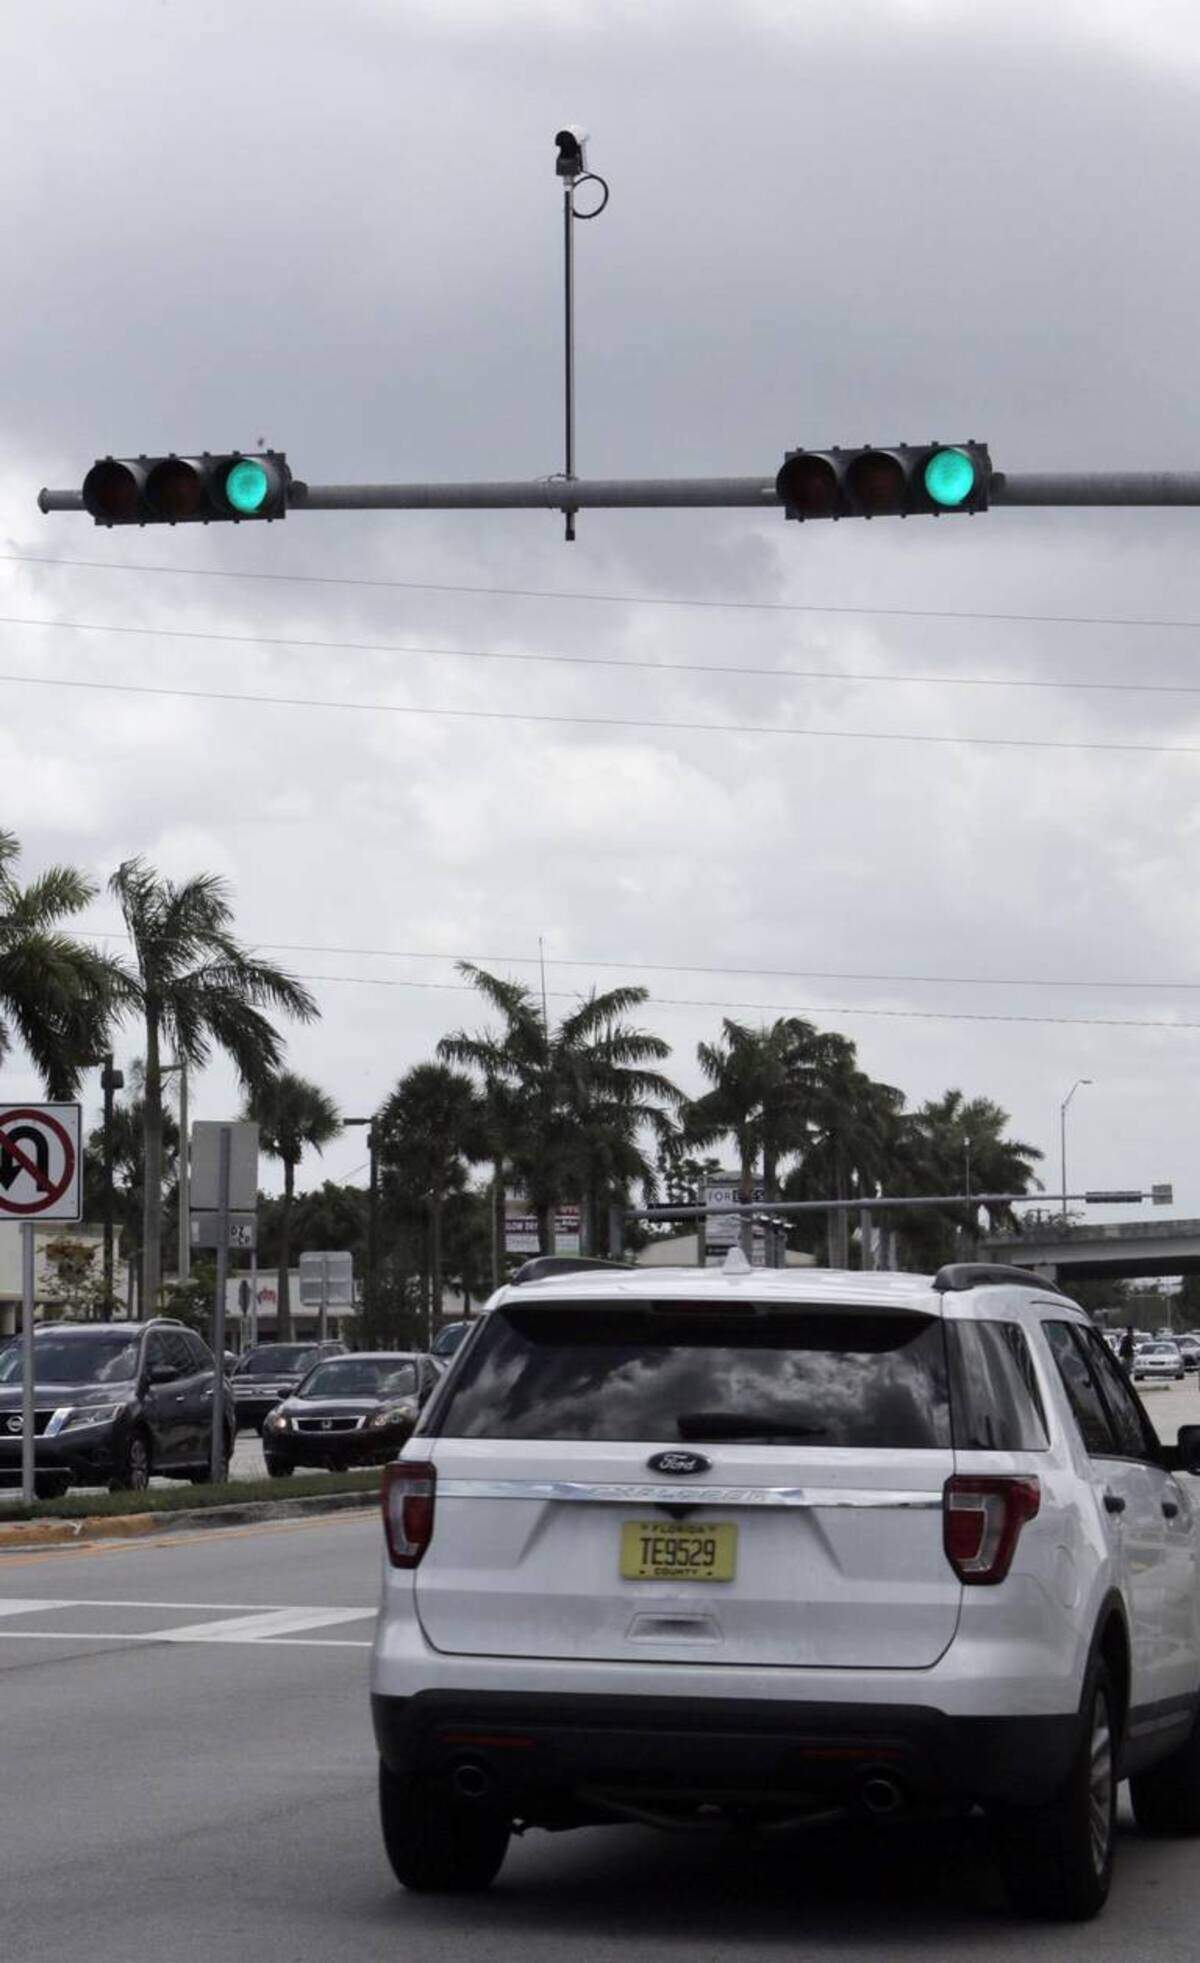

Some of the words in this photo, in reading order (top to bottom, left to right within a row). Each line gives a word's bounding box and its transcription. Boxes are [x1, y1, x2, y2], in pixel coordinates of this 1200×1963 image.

[658, 1453, 697, 1471] Ford
[651, 1525, 705, 1534] FLORIDA
[640, 1537, 716, 1567] TE9529
[654, 1568, 698, 1576] COUNTY
